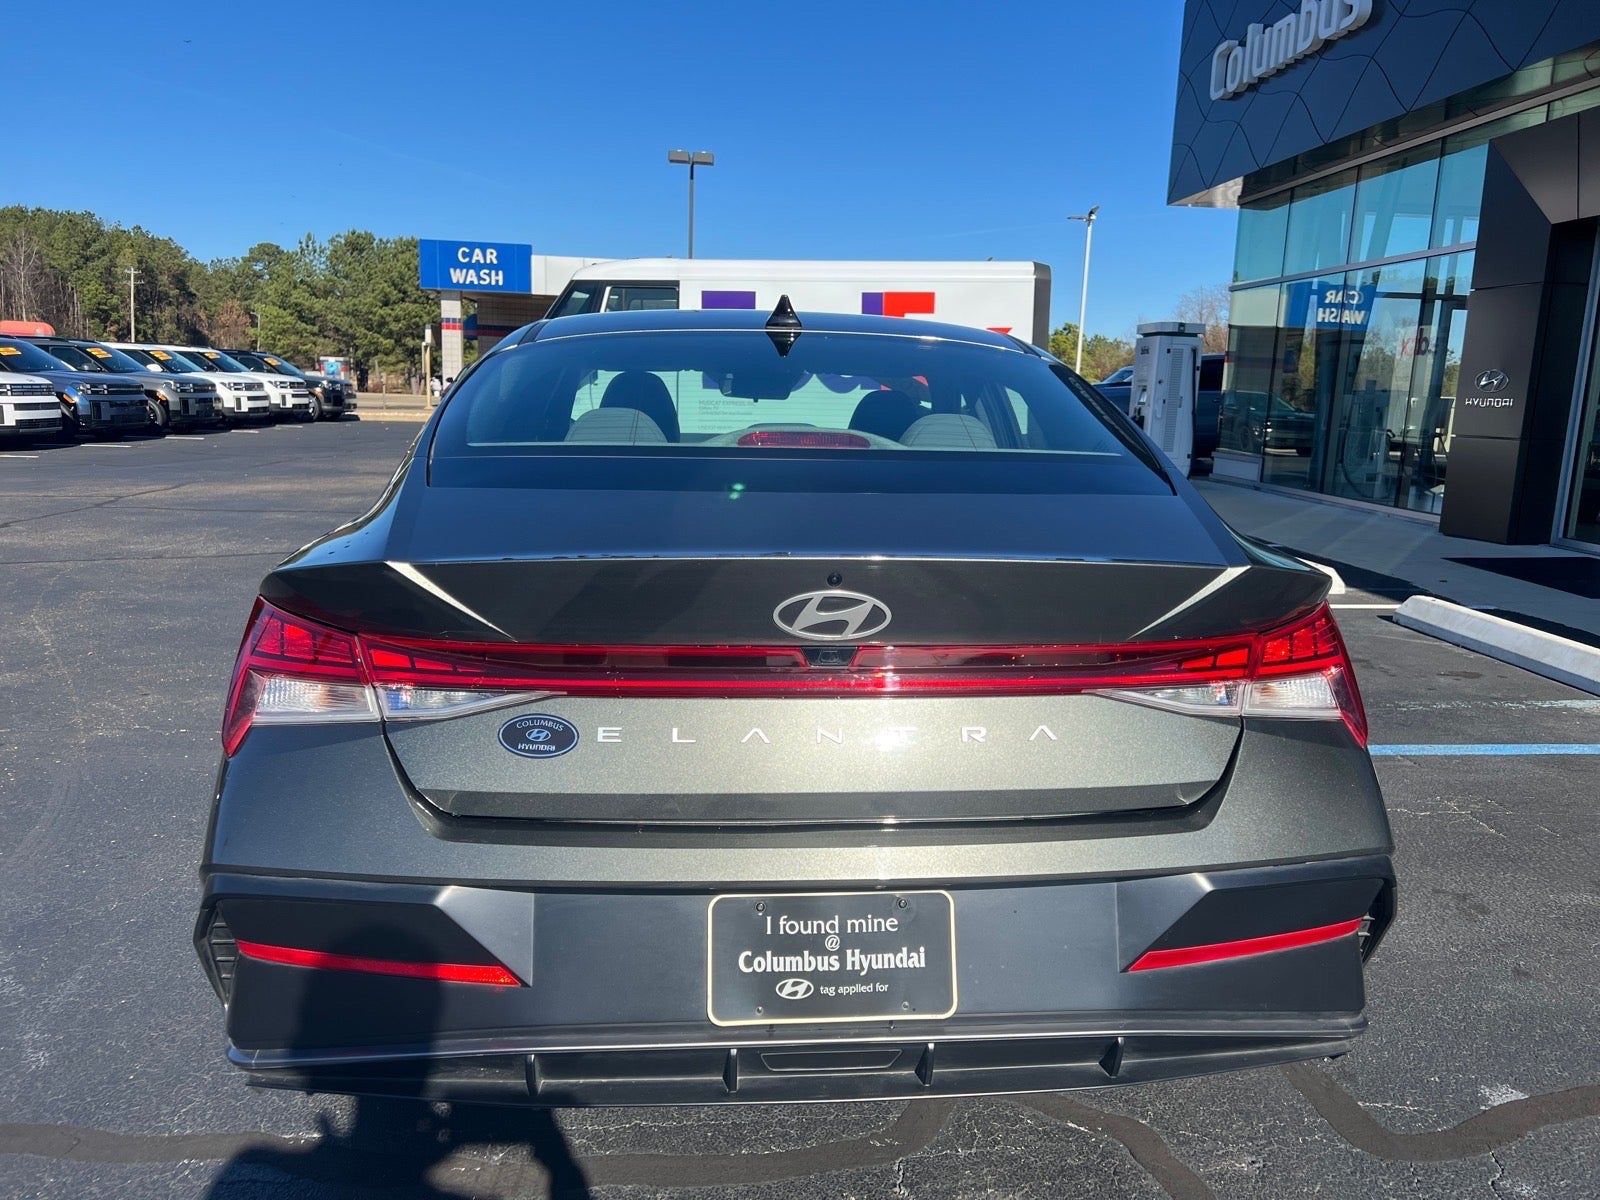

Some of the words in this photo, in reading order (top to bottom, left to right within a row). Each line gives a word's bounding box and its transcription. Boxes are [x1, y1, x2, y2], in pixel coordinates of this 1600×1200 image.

[1210, 0, 1373, 100] Columbus
[457, 247, 498, 264] CAR
[449, 267, 504, 286] WASH
[1465, 397, 1514, 408] HYUNDAI
[516, 720, 564, 731] COLUMBUS
[597, 724, 1057, 744] ELANTRA
[518, 744, 555, 752] HYUNDAI
[766, 917, 772, 934] I
[779, 915, 839, 934] found
[847, 914, 899, 933] mine
[824, 934, 841, 952] @
[738, 950, 840, 973] Columbus
[846, 946, 926, 976] Hyundai
[820, 985, 836, 996] tag
[838, 983, 873, 996] applied
[876, 982, 889, 992] for
